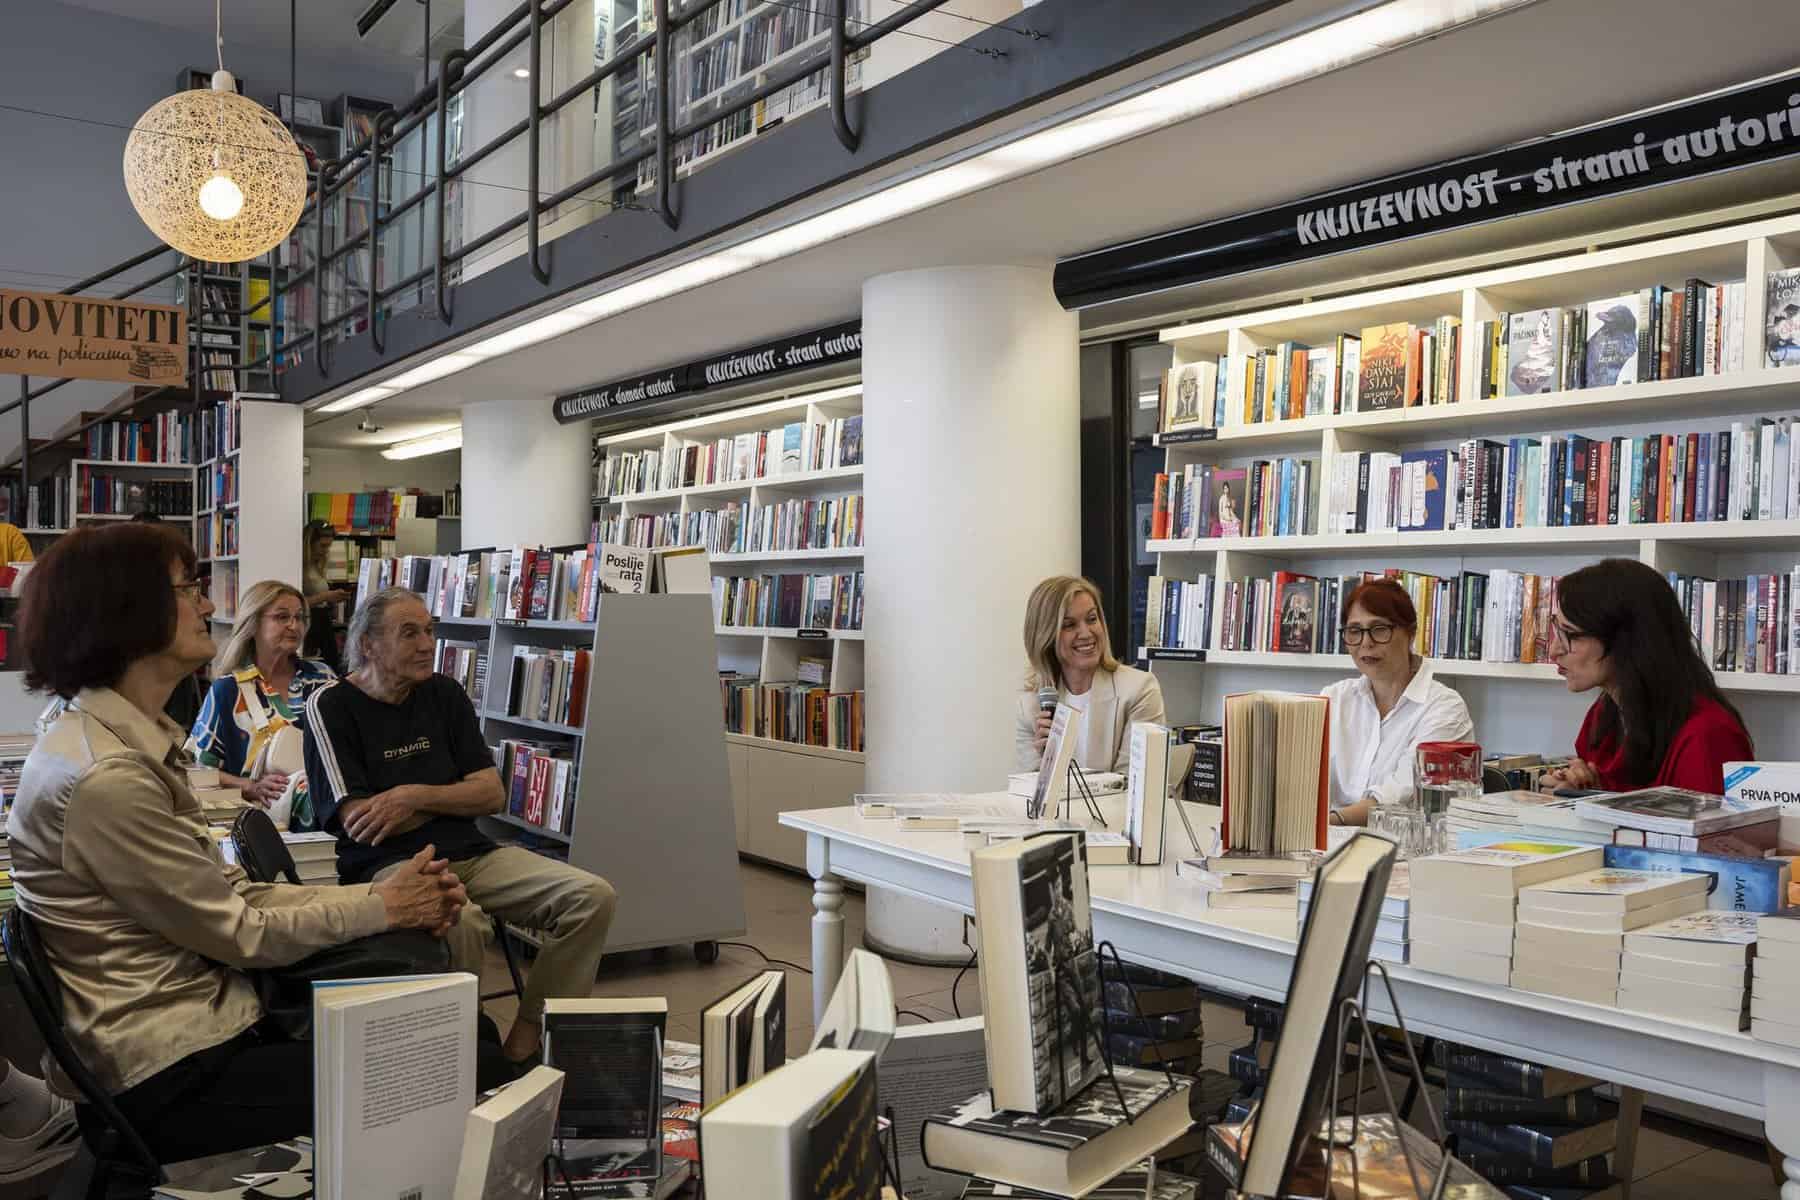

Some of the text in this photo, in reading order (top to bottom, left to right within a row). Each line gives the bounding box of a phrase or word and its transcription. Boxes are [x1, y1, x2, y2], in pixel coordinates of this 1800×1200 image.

[1297, 168, 1499, 246] KNJIZEVNOST
[1533, 131, 1650, 194] strani
[1662, 92, 1800, 165] autori
[0, 294, 182, 345] OVITETI
[27, 347, 49, 360] na
[58, 338, 134, 366] policama
[606, 553, 644, 571] Poslije
[619, 568, 642, 582] rata
[1740, 788, 1772, 802] PRVA
